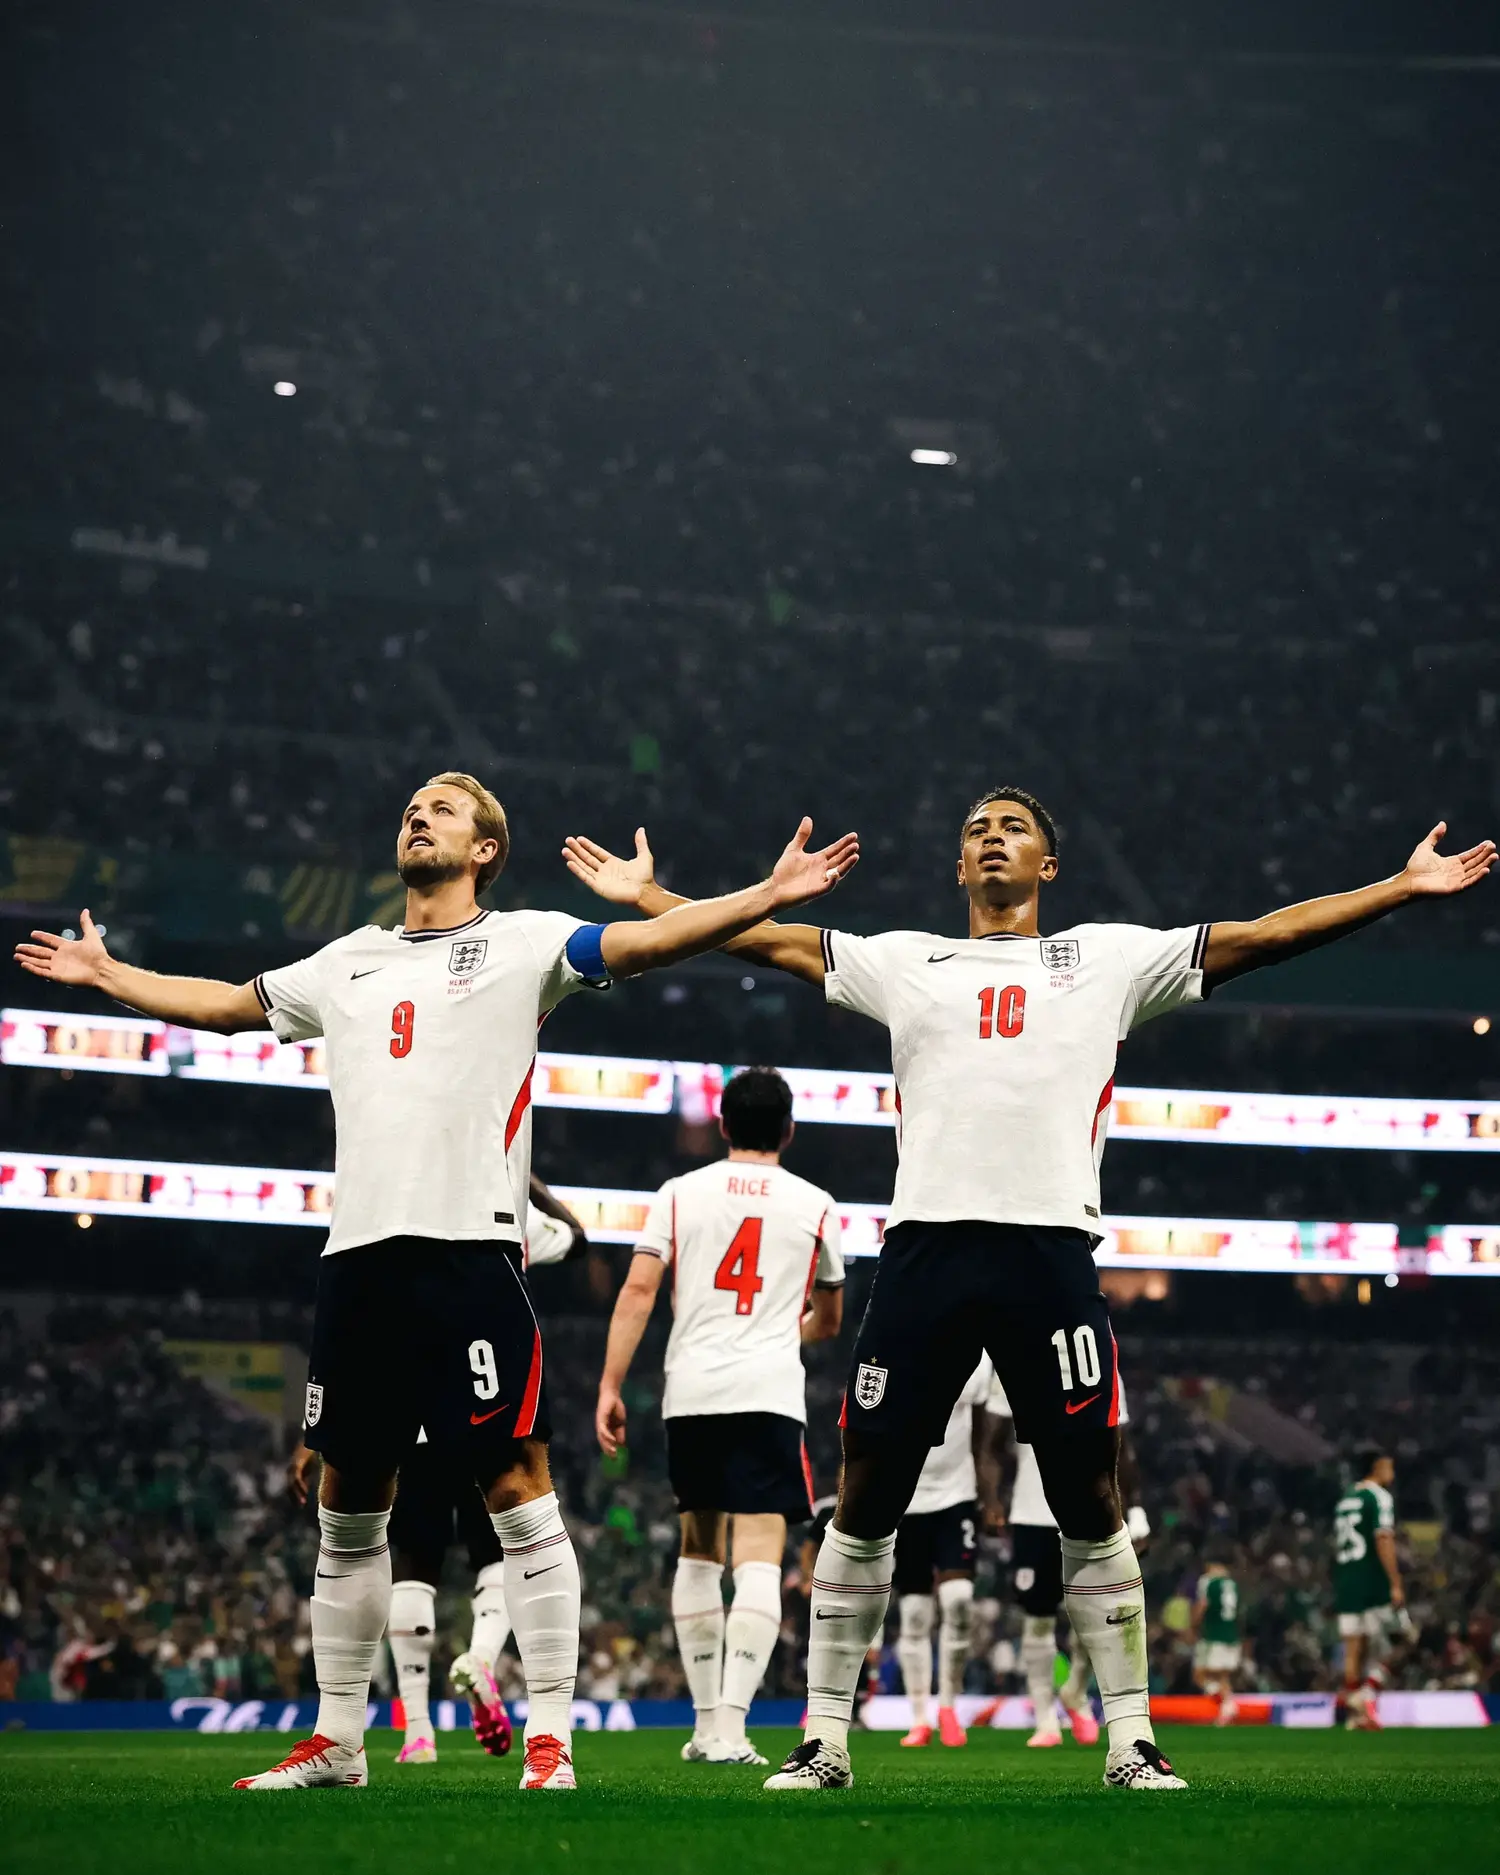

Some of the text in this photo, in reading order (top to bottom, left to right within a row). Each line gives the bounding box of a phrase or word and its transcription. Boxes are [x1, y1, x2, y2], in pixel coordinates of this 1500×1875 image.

[389, 1000, 415, 1059] 9
[978, 985, 1026, 1039] 10
[727, 1176, 772, 1197] RICE
[714, 1217, 764, 1316] 4
[468, 1339, 500, 1400] 9
[1051, 1324, 1101, 1391] 10
